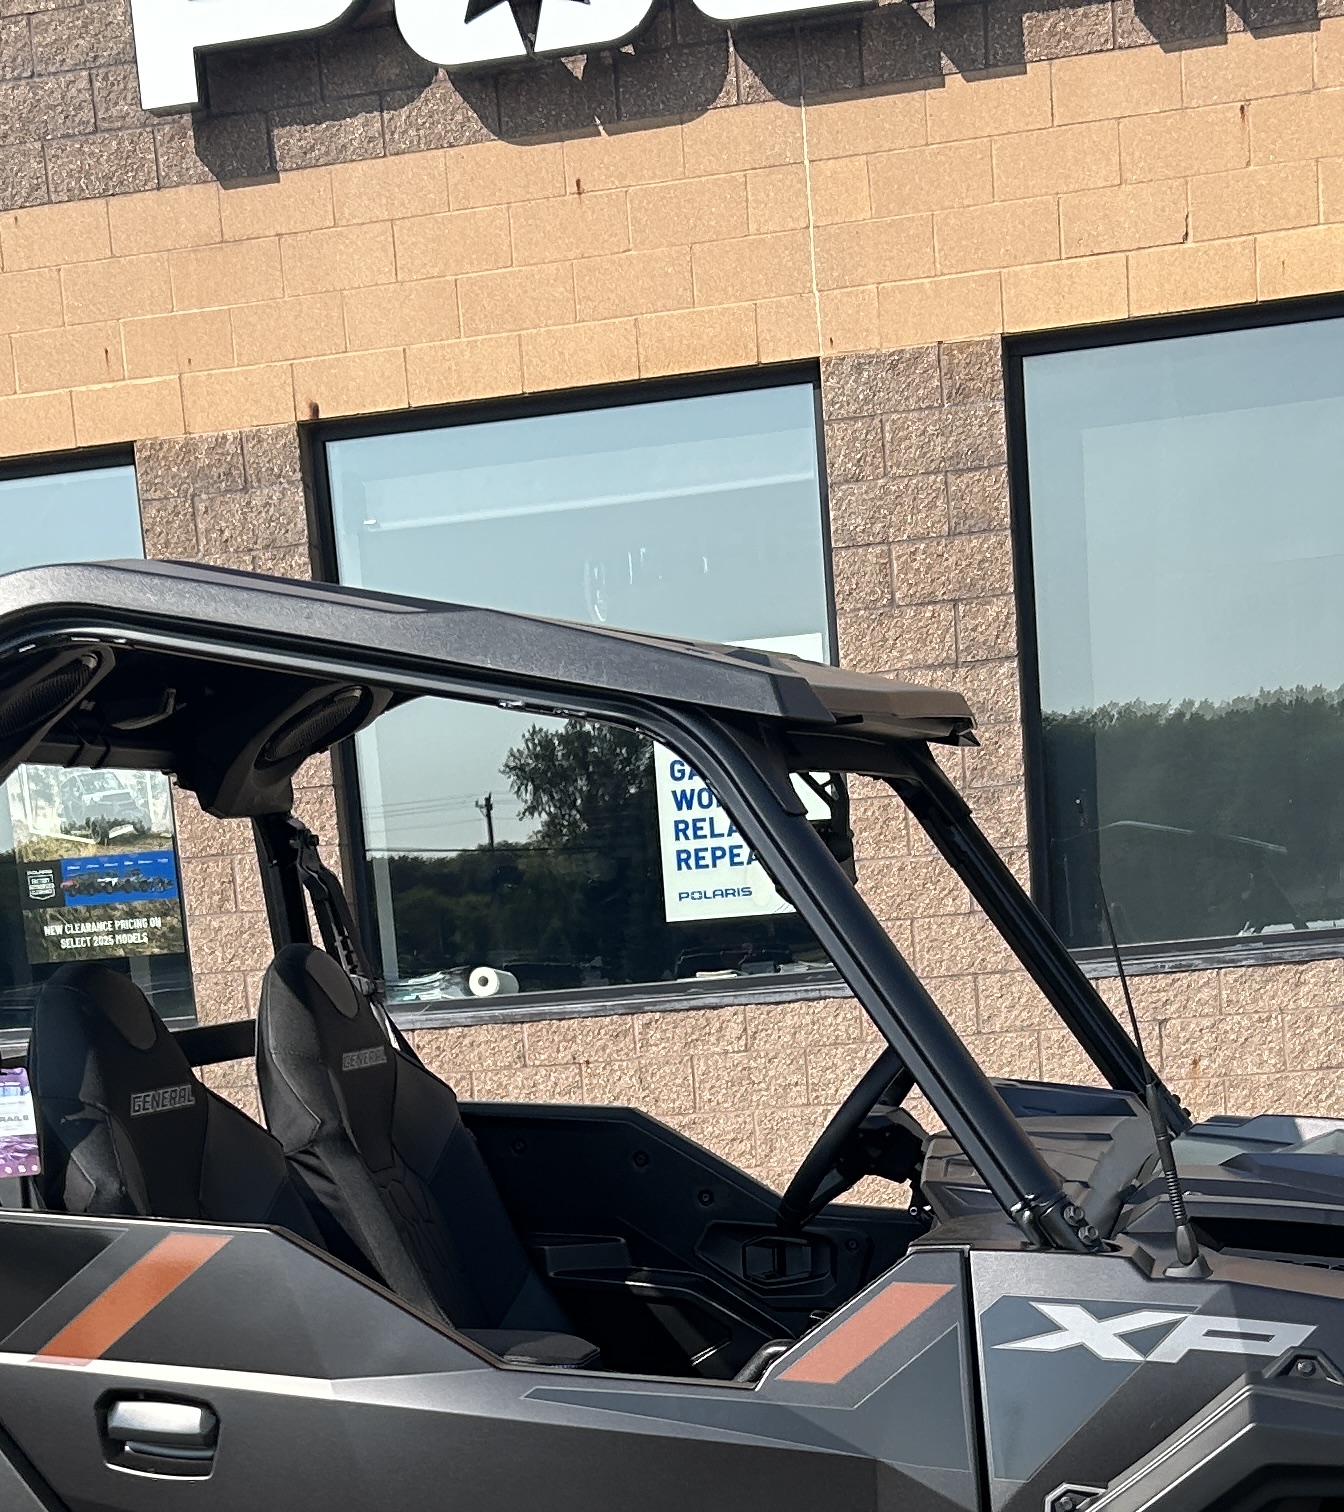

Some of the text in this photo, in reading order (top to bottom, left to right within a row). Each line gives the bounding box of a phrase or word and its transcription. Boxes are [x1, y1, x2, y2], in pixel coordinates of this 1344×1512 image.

[674, 816, 738, 841] RELA
[676, 844, 758, 871] REPEA
[678, 887, 753, 901] POLARIS
[44, 917, 162, 936] NEW CLEARANCE PRICING ON
[60, 932, 149, 949] SELECT 2025 MODELS
[342, 1046, 388, 1071] GENERAL
[130, 1084, 197, 1118] GENERAL
[990, 1301, 1318, 1363] XP
